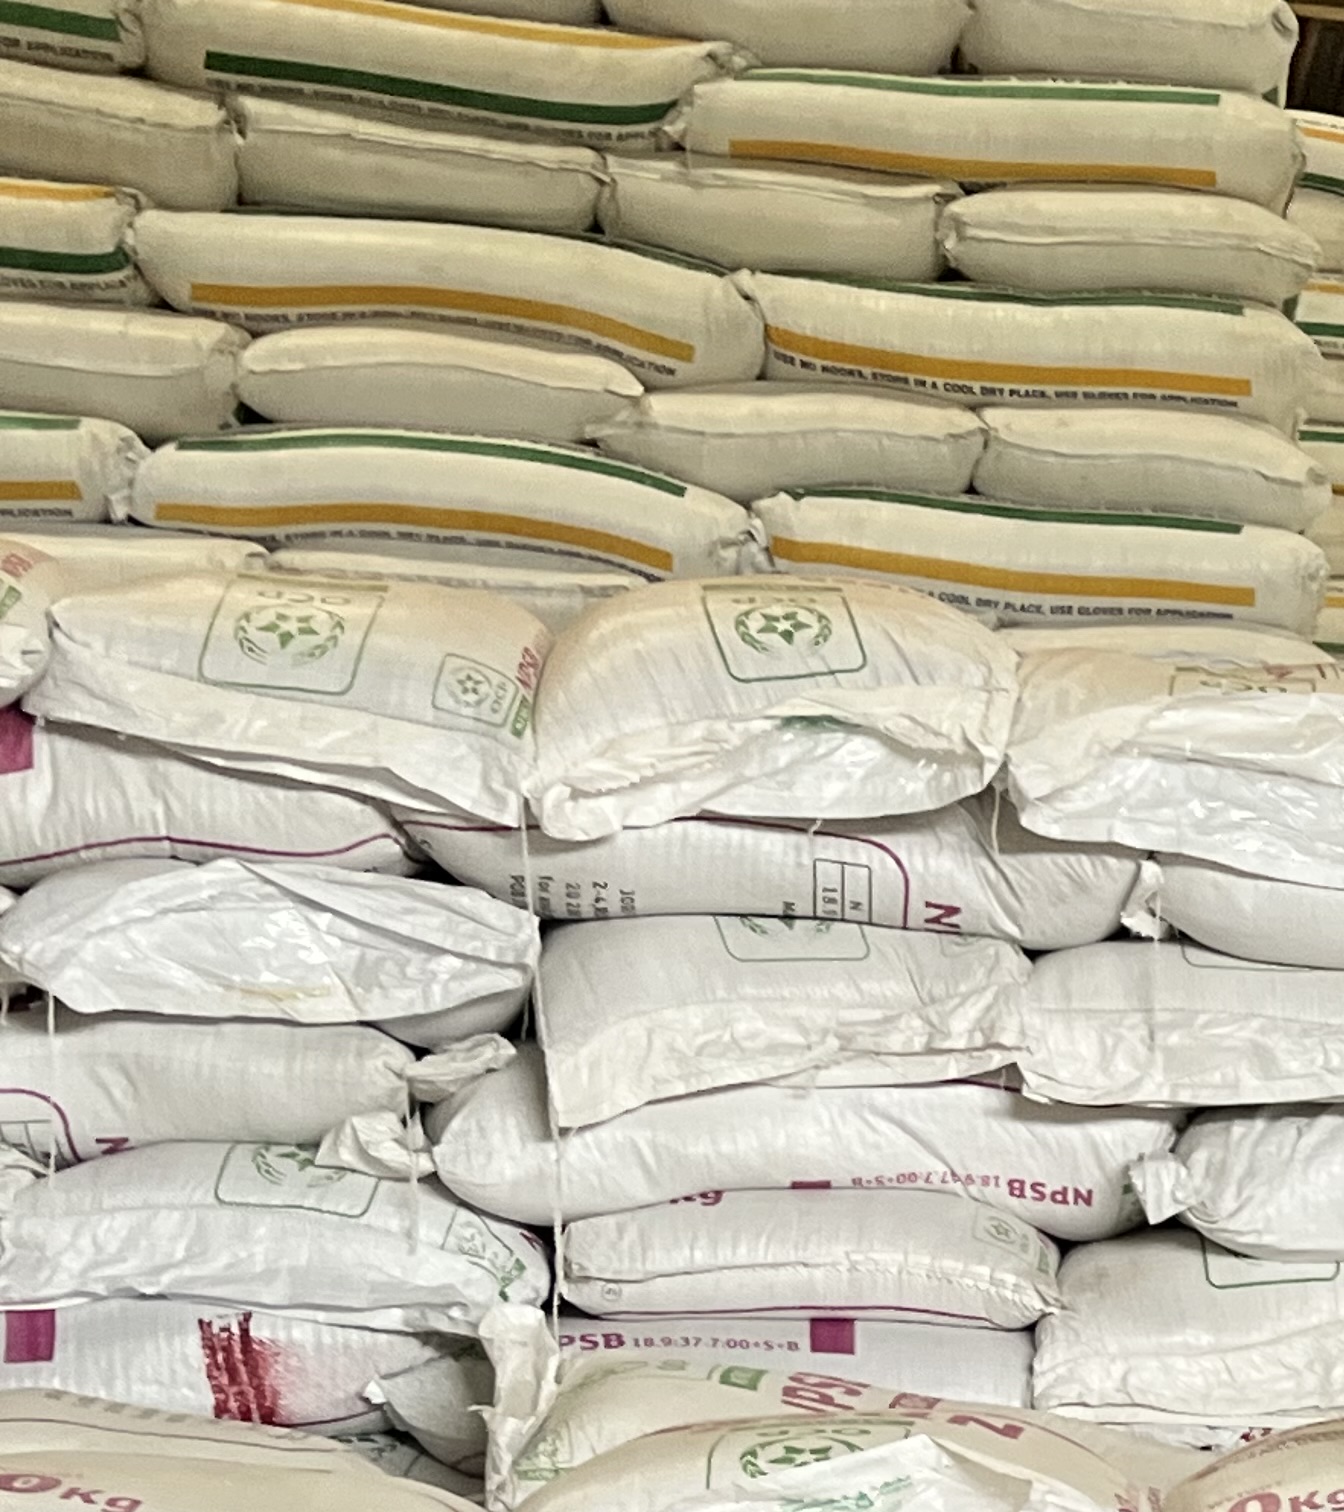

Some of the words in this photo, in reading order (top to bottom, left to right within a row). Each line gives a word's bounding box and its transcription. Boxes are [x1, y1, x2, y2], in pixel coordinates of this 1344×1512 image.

[943, 382, 977, 396] COOL
[980, 385, 1004, 397] DRY
[976, 597, 1000, 608] DRY
[1050, 605, 1073, 616] USE
[1008, 1178, 1093, 1207] NPSB
